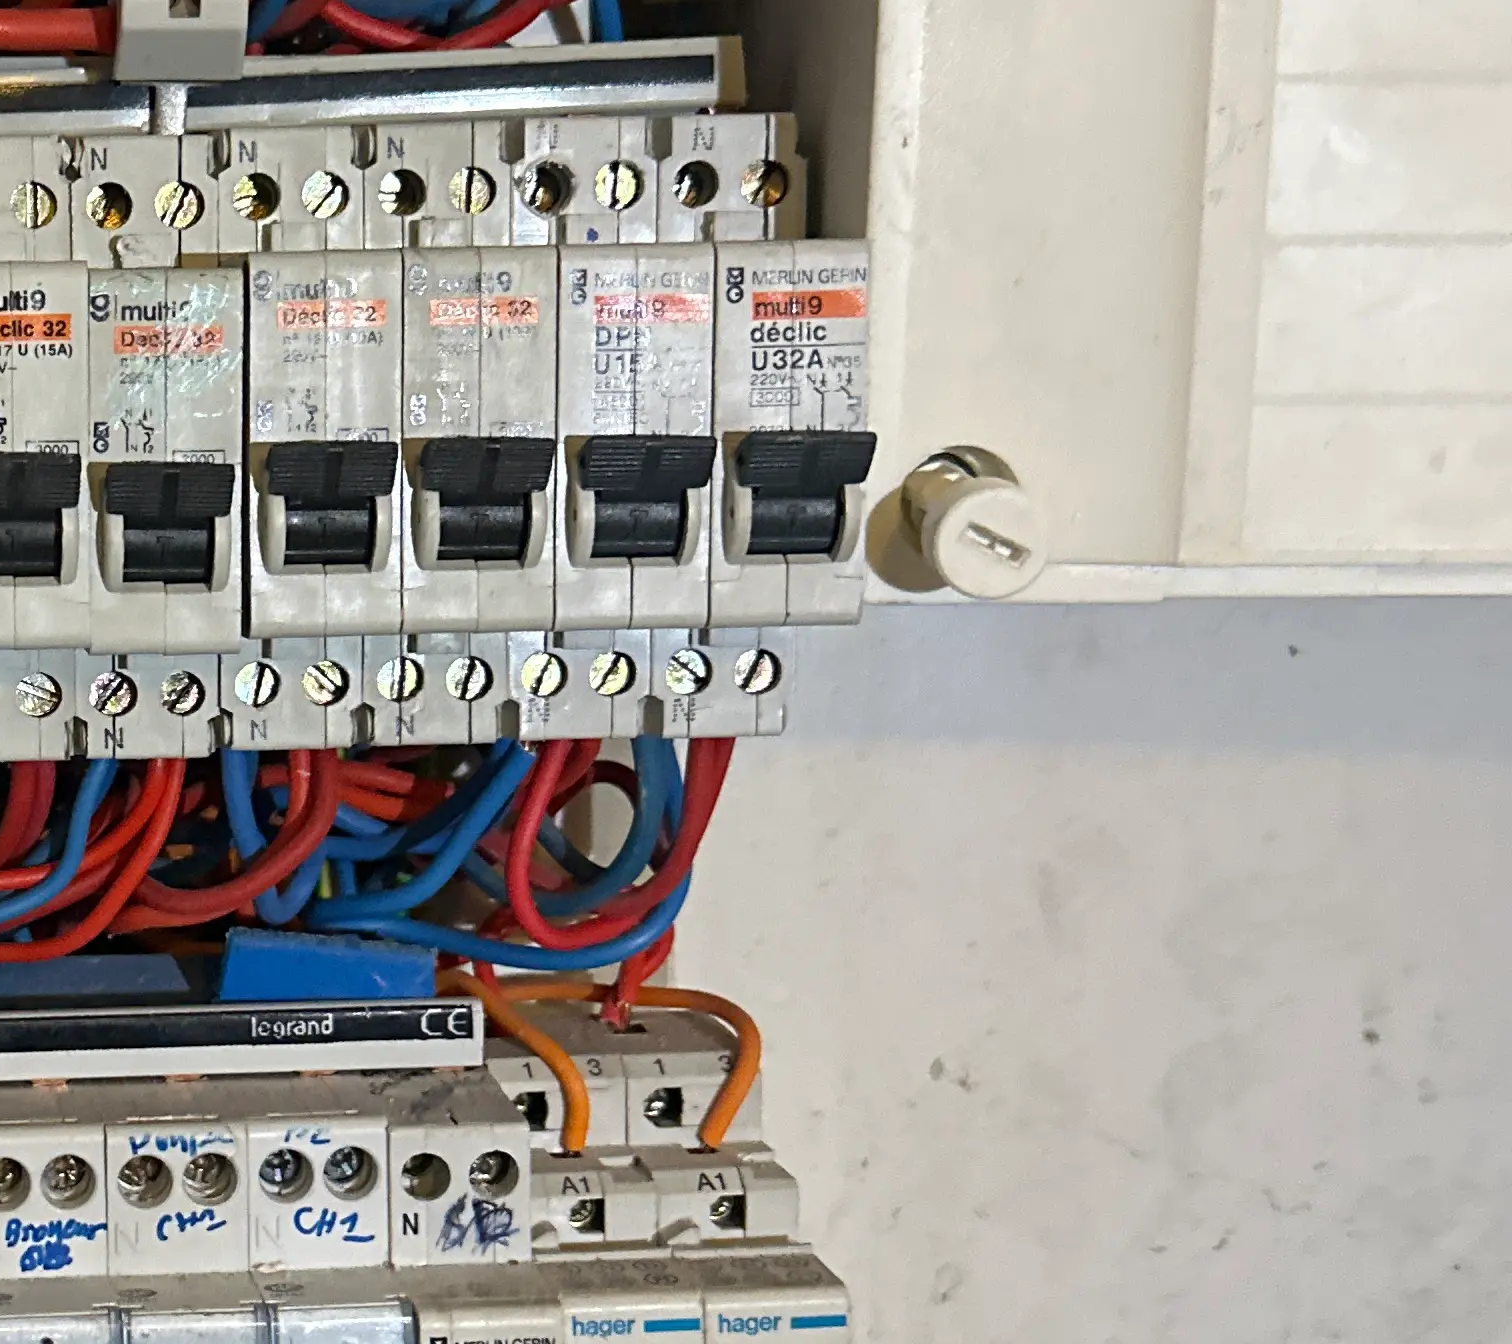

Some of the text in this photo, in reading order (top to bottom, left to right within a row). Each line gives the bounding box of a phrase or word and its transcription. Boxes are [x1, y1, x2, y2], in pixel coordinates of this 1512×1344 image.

[750, 267, 814, 285] MERLIN
[42, 319, 67, 337] 32
[750, 322, 827, 344] déclic
[17, 344, 29, 357] U
[33, 343, 73, 359] (15A)
[250, 1008, 469, 1039] legrand CE
[401, 1213, 420, 1236] N
[571, 1316, 635, 1338] hager
[717, 1313, 782, 1335] hager
